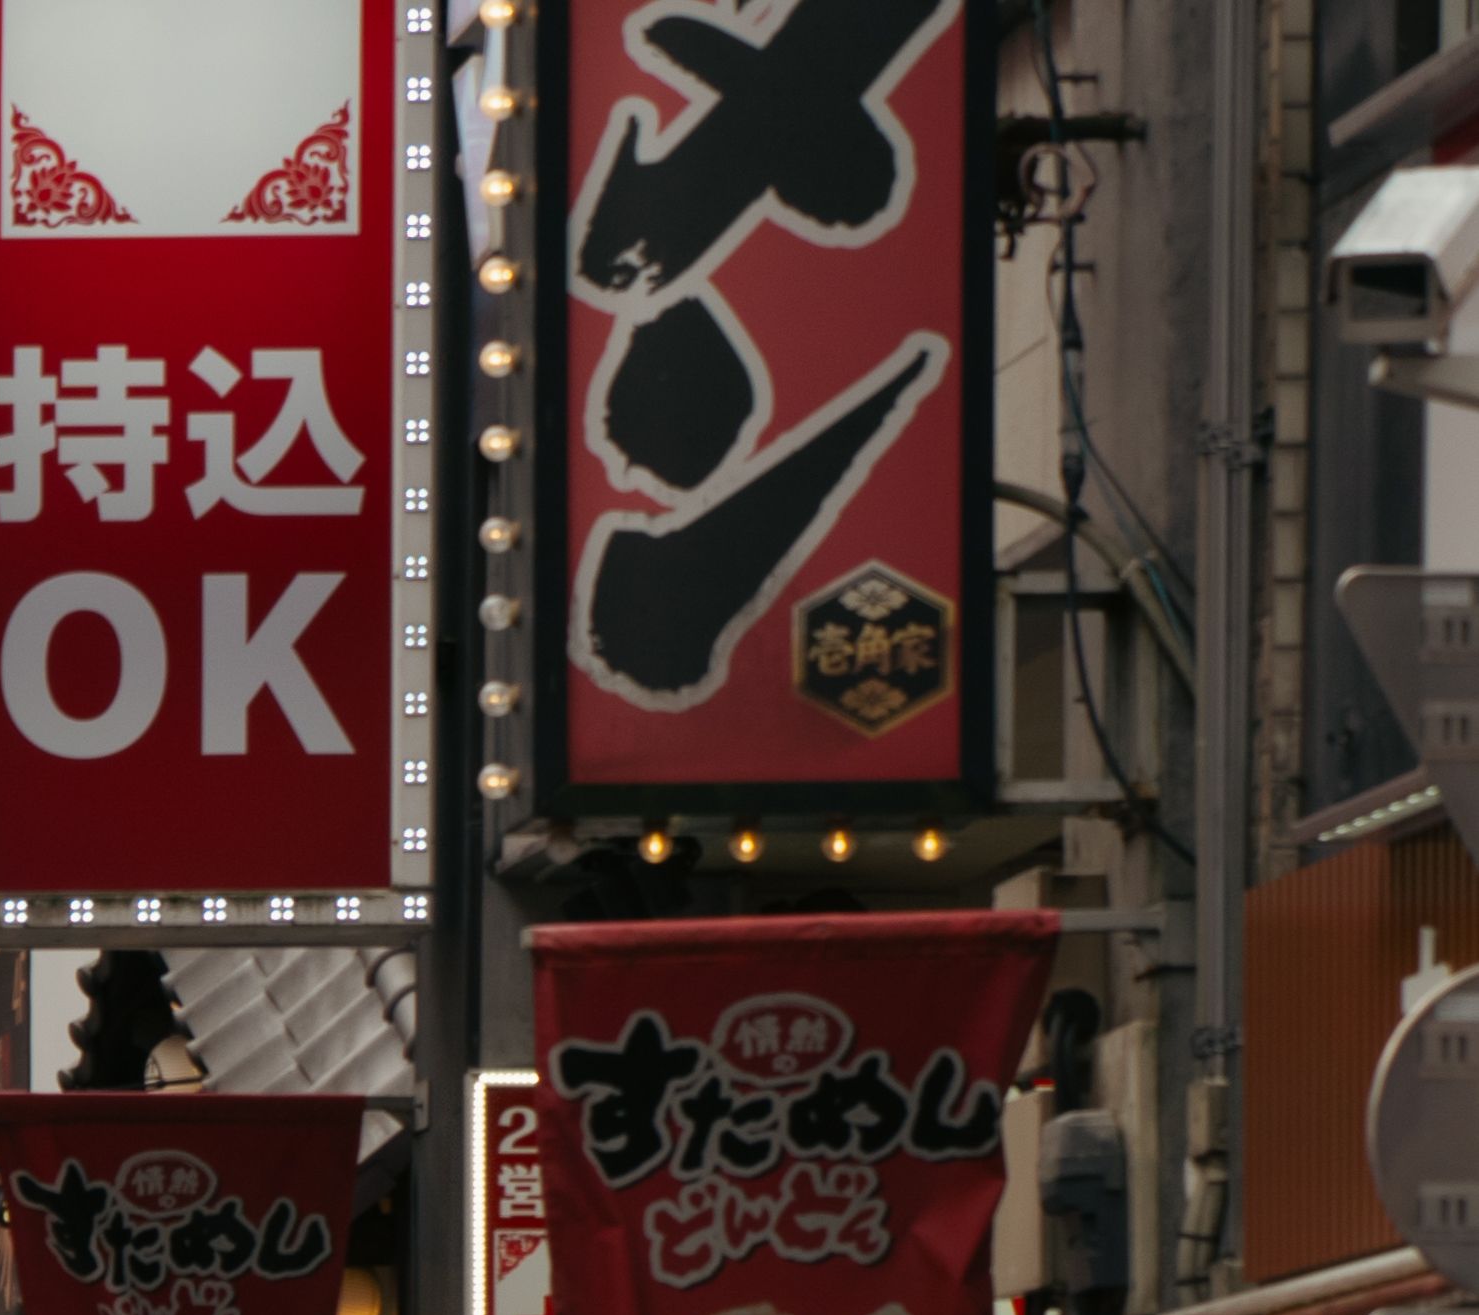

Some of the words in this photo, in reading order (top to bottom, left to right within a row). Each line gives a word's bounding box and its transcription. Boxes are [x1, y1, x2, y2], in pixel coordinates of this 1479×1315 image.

[0, 571, 356, 760] OK
[733, 1015, 829, 1055] 情熱
[131, 1161, 200, 1197] 情熱
[645, 1163, 890, 1288] どんどん
